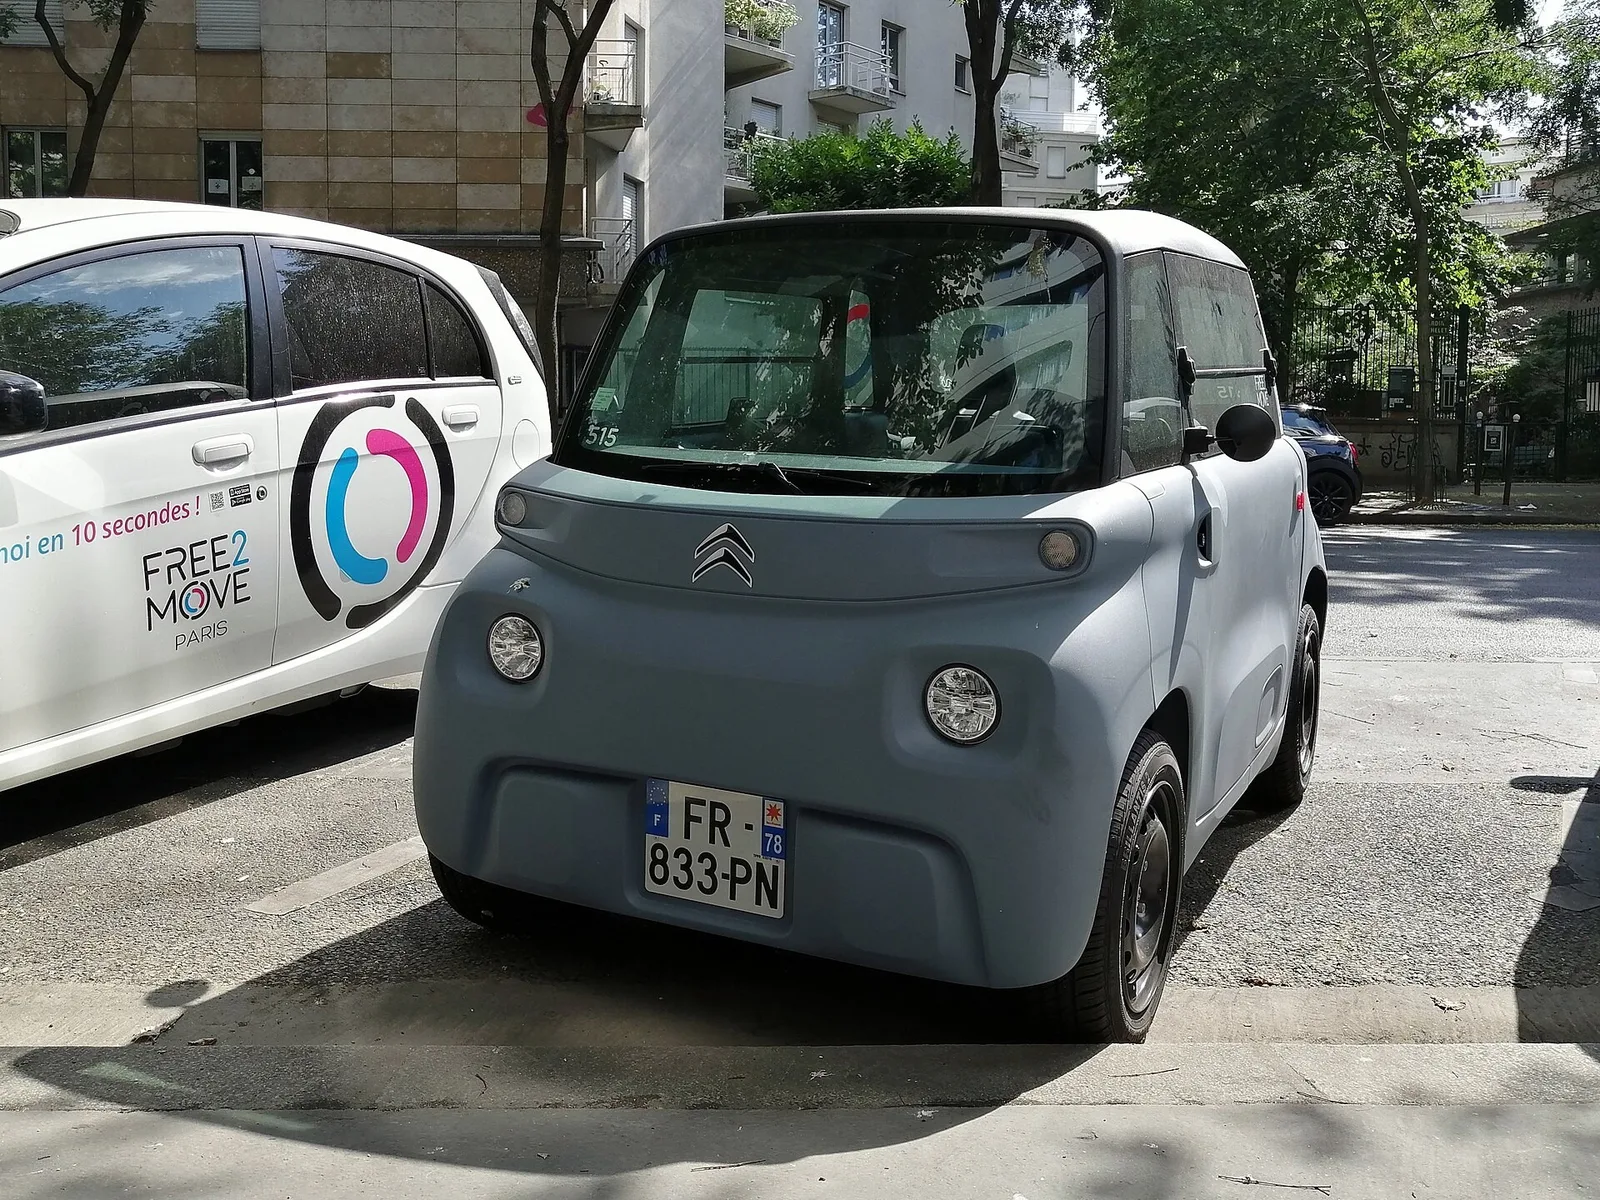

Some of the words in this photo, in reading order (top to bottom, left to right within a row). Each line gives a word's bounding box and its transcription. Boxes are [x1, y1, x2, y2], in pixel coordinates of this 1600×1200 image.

[585, 425, 619, 447] 515
[38, 533, 64, 555] en
[71, 521, 97, 547] 10
[102, 501, 190, 540] secondes
[142, 530, 249, 591] FREE2
[146, 567, 251, 632] MOVE
[175, 620, 229, 651] PARIS
[654, 814, 661, 827] F
[764, 832, 782, 854] 78
[649, 842, 779, 910] 833-PN
